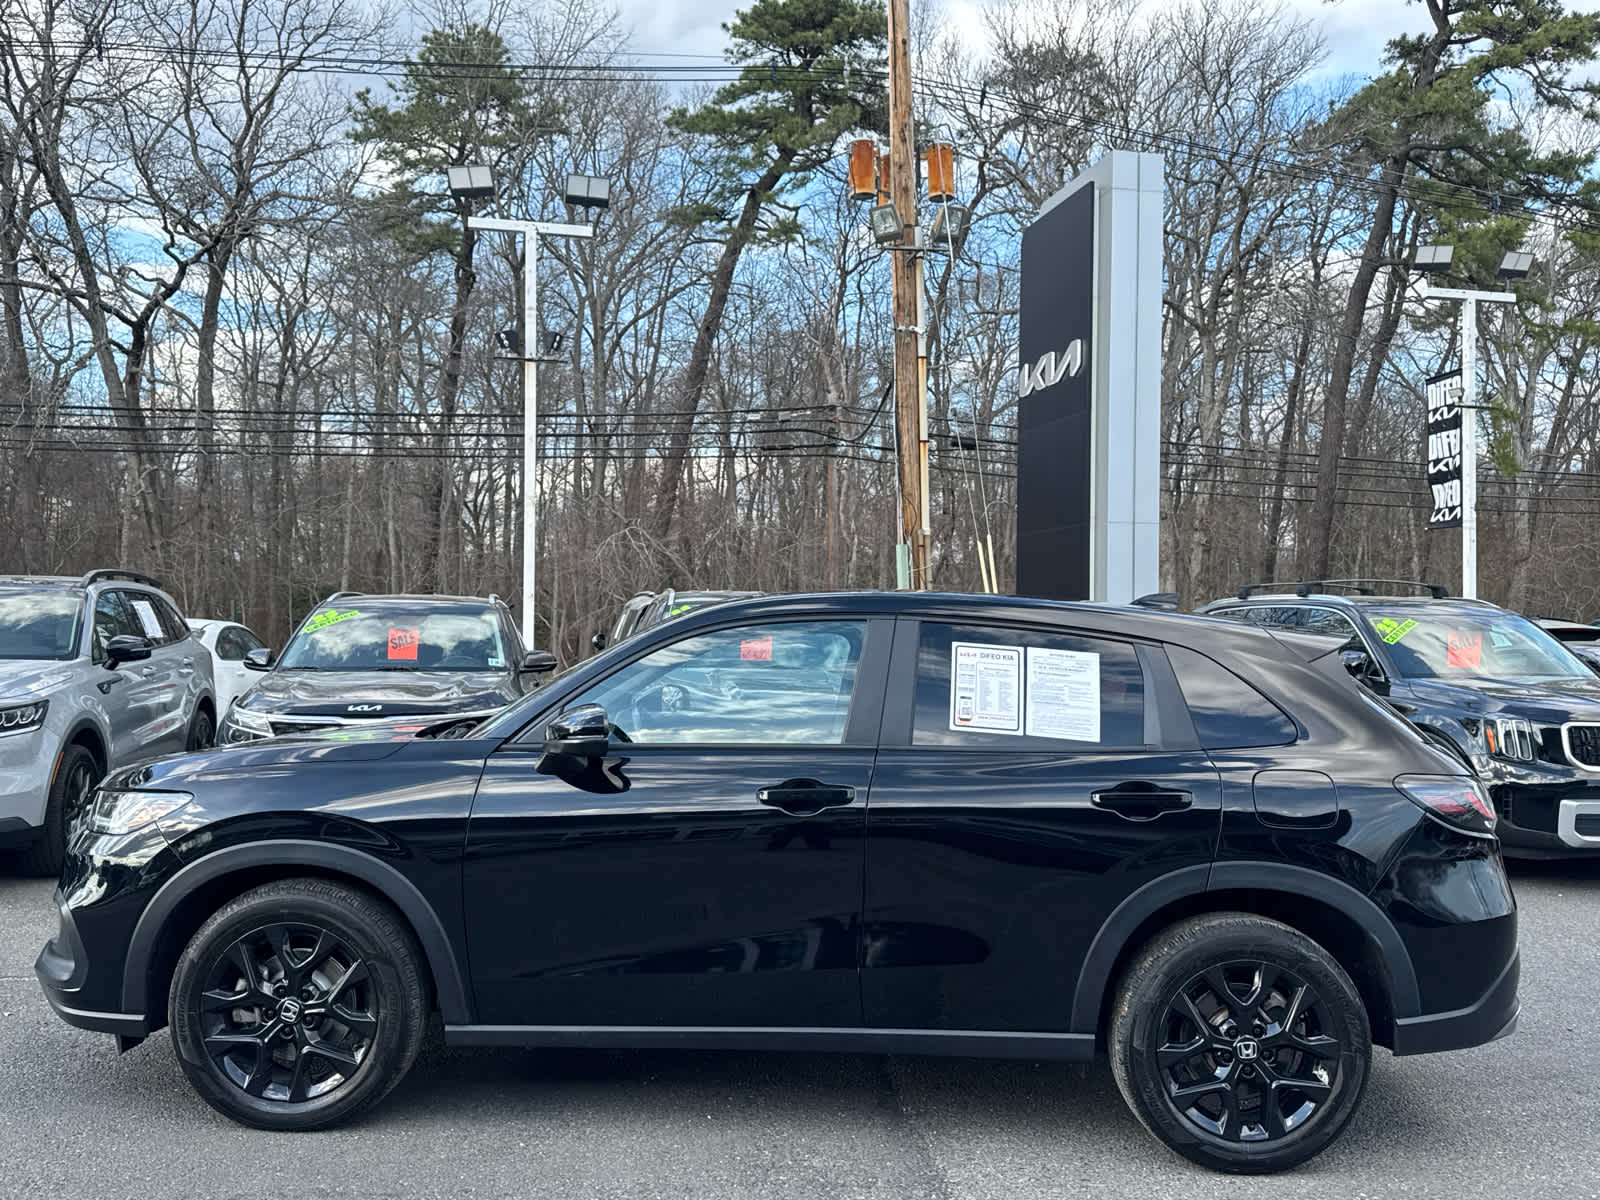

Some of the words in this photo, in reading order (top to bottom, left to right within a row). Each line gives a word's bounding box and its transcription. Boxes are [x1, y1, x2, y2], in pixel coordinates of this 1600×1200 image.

[1019, 338, 1082, 398] KIA
[1430, 505, 1462, 523] KIA
[390, 631, 415, 650] SALE
[347, 704, 383, 712] KIA
